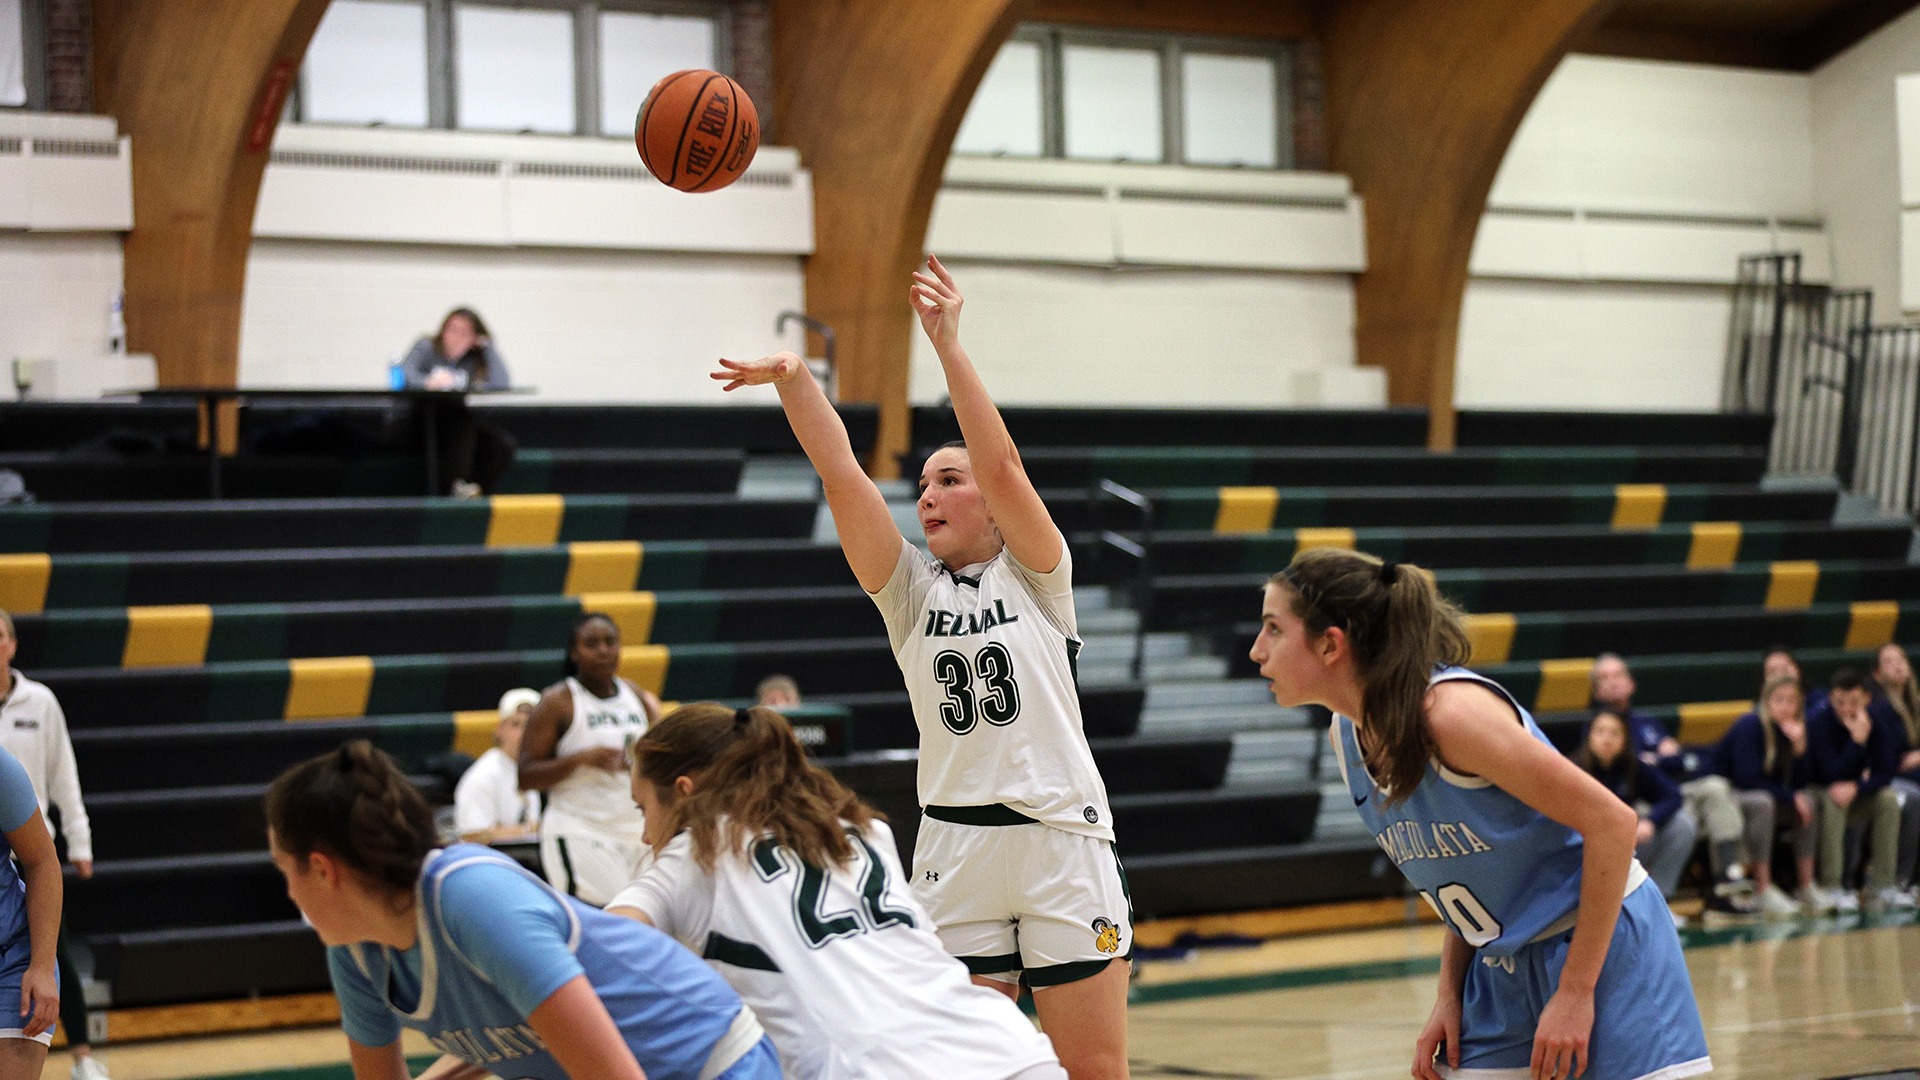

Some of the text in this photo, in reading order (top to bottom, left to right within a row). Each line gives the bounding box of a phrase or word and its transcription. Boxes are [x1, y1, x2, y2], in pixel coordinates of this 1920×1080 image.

[686, 92, 729, 176] THE ROCK
[933, 641, 1021, 736] 33
[748, 826, 919, 950] 22
[1419, 881, 1503, 948] 0
